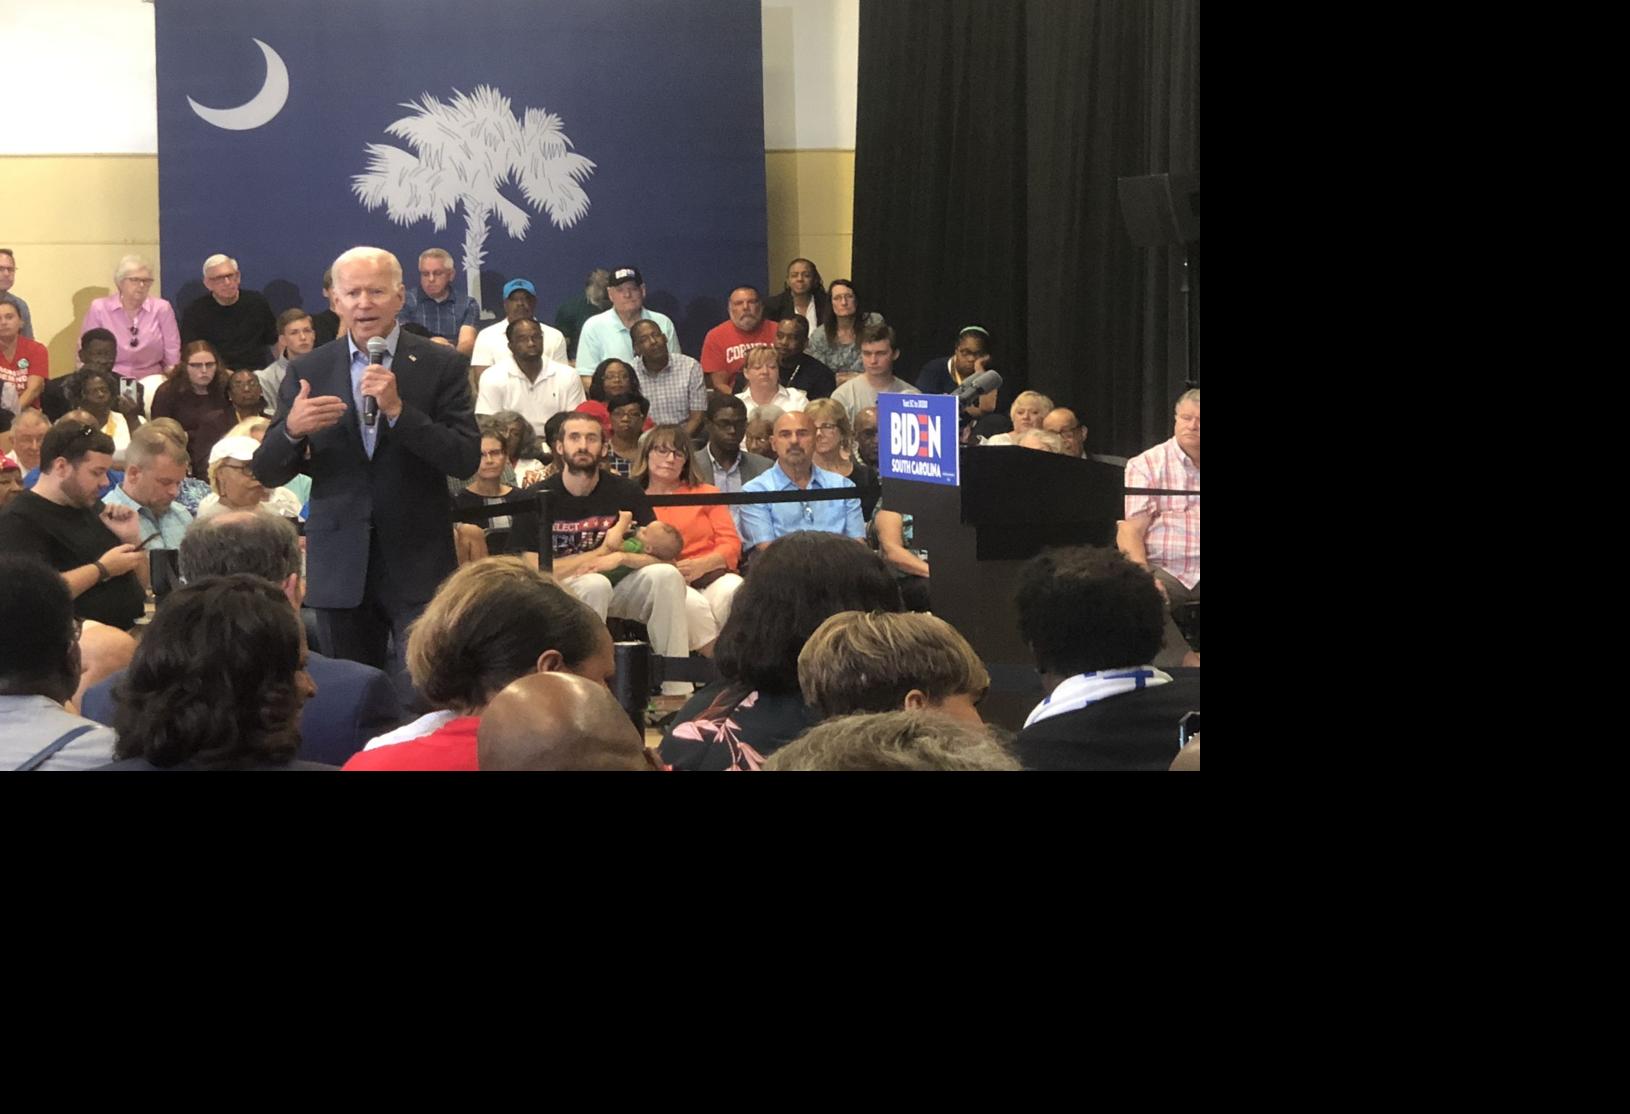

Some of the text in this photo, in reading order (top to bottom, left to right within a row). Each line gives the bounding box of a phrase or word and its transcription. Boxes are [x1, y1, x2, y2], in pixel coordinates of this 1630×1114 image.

[891, 412, 941, 459] BIDEN
[892, 459, 941, 478] SOUTH CAROLINA
